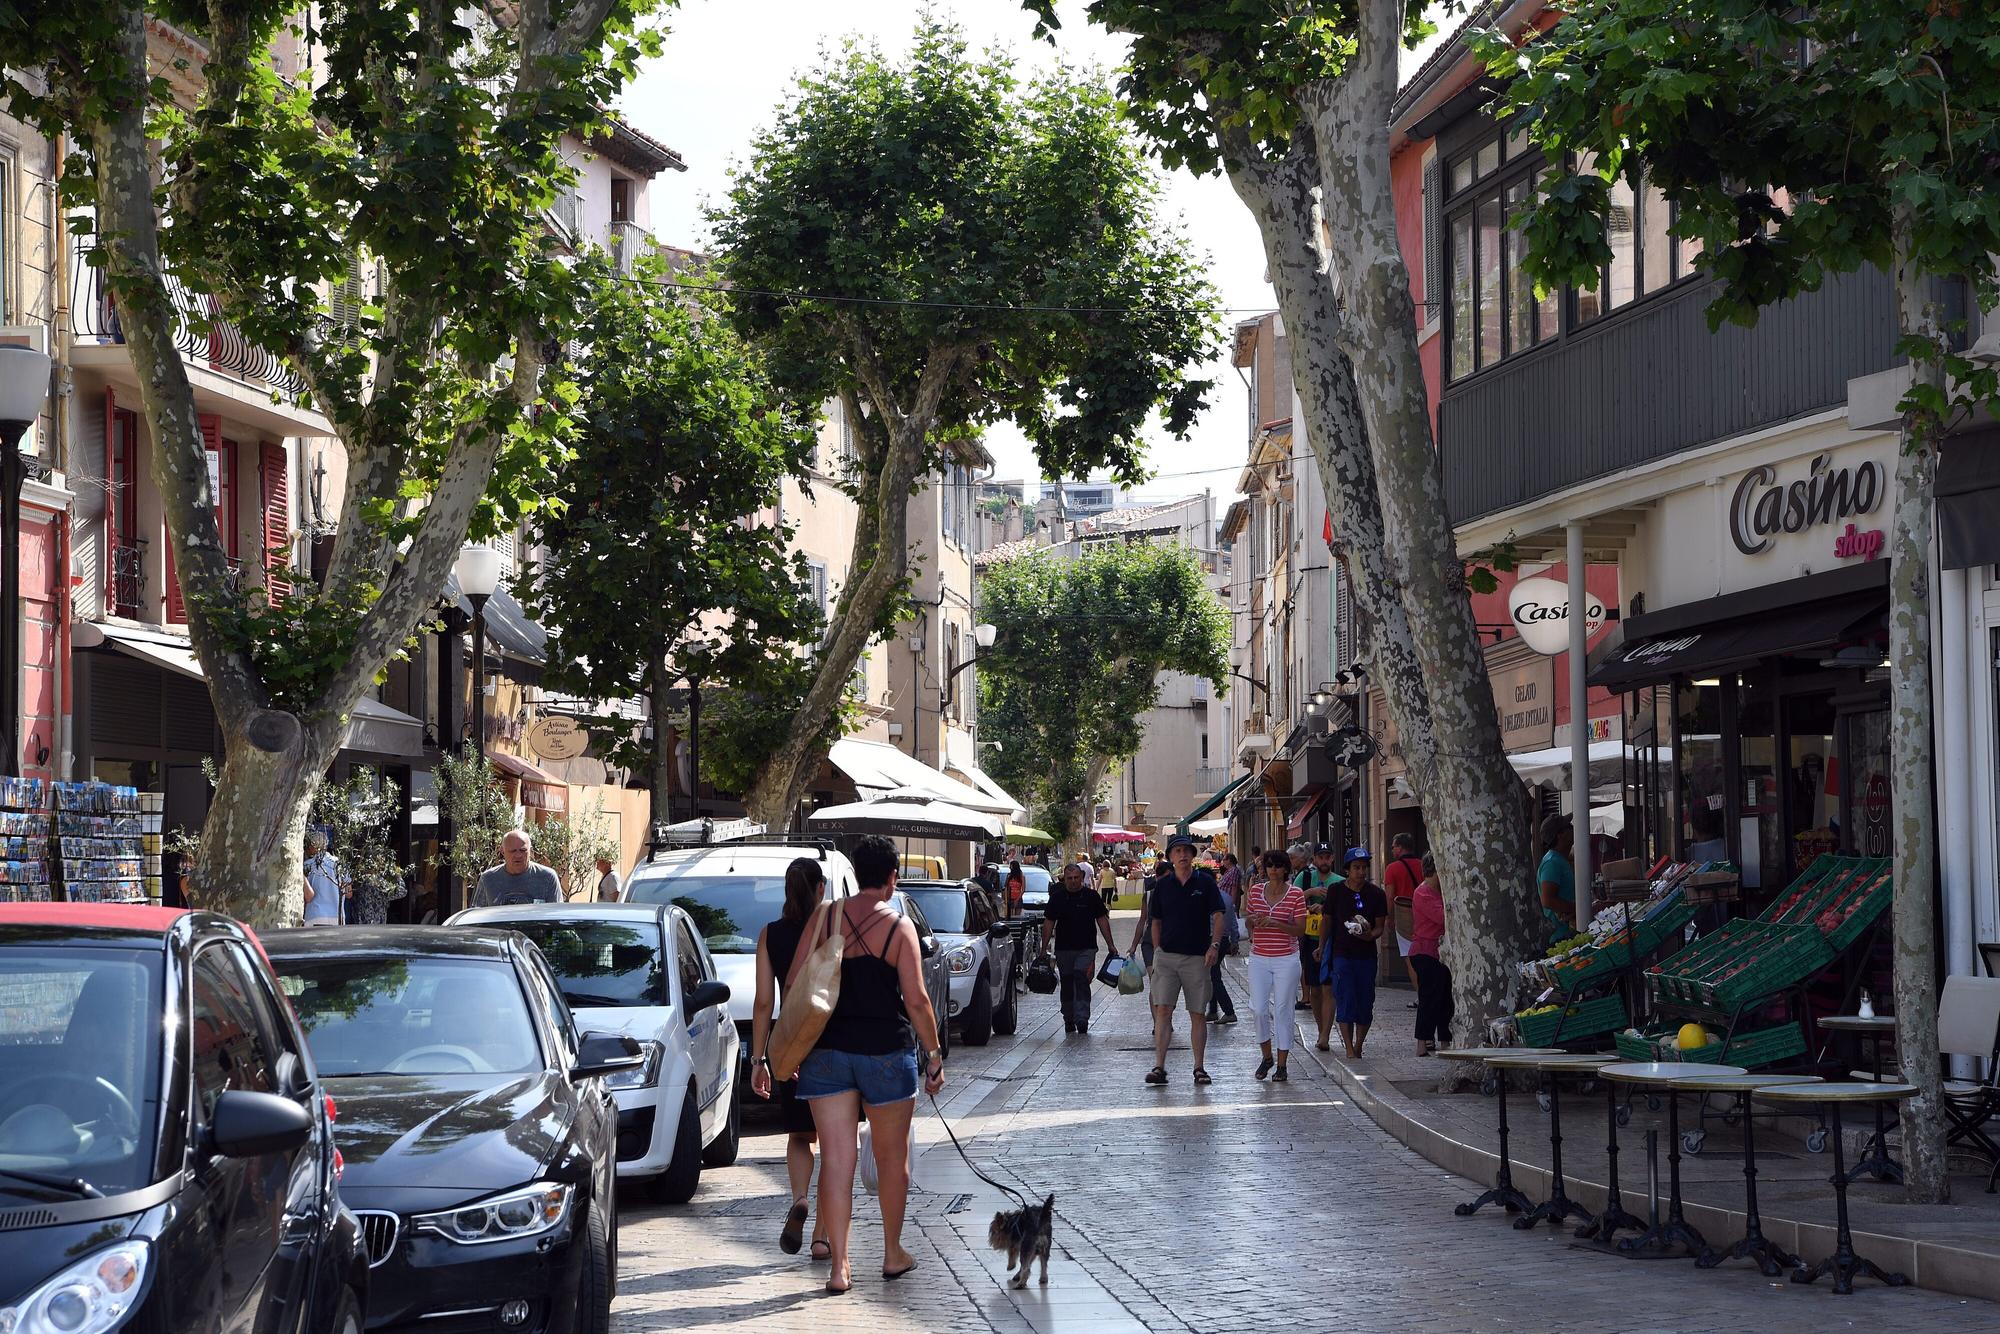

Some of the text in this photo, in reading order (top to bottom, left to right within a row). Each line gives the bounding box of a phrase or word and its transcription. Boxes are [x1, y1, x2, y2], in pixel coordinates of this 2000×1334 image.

[1729, 454, 1883, 556] Casino
[1834, 523, 1884, 562] shop
[1514, 602, 1602, 625] Casio
[1622, 634, 1702, 663] Casino
[1515, 682, 1537, 703] GELATO
[817, 822, 829, 830] LE
[911, 825, 941, 834] CUISINE
